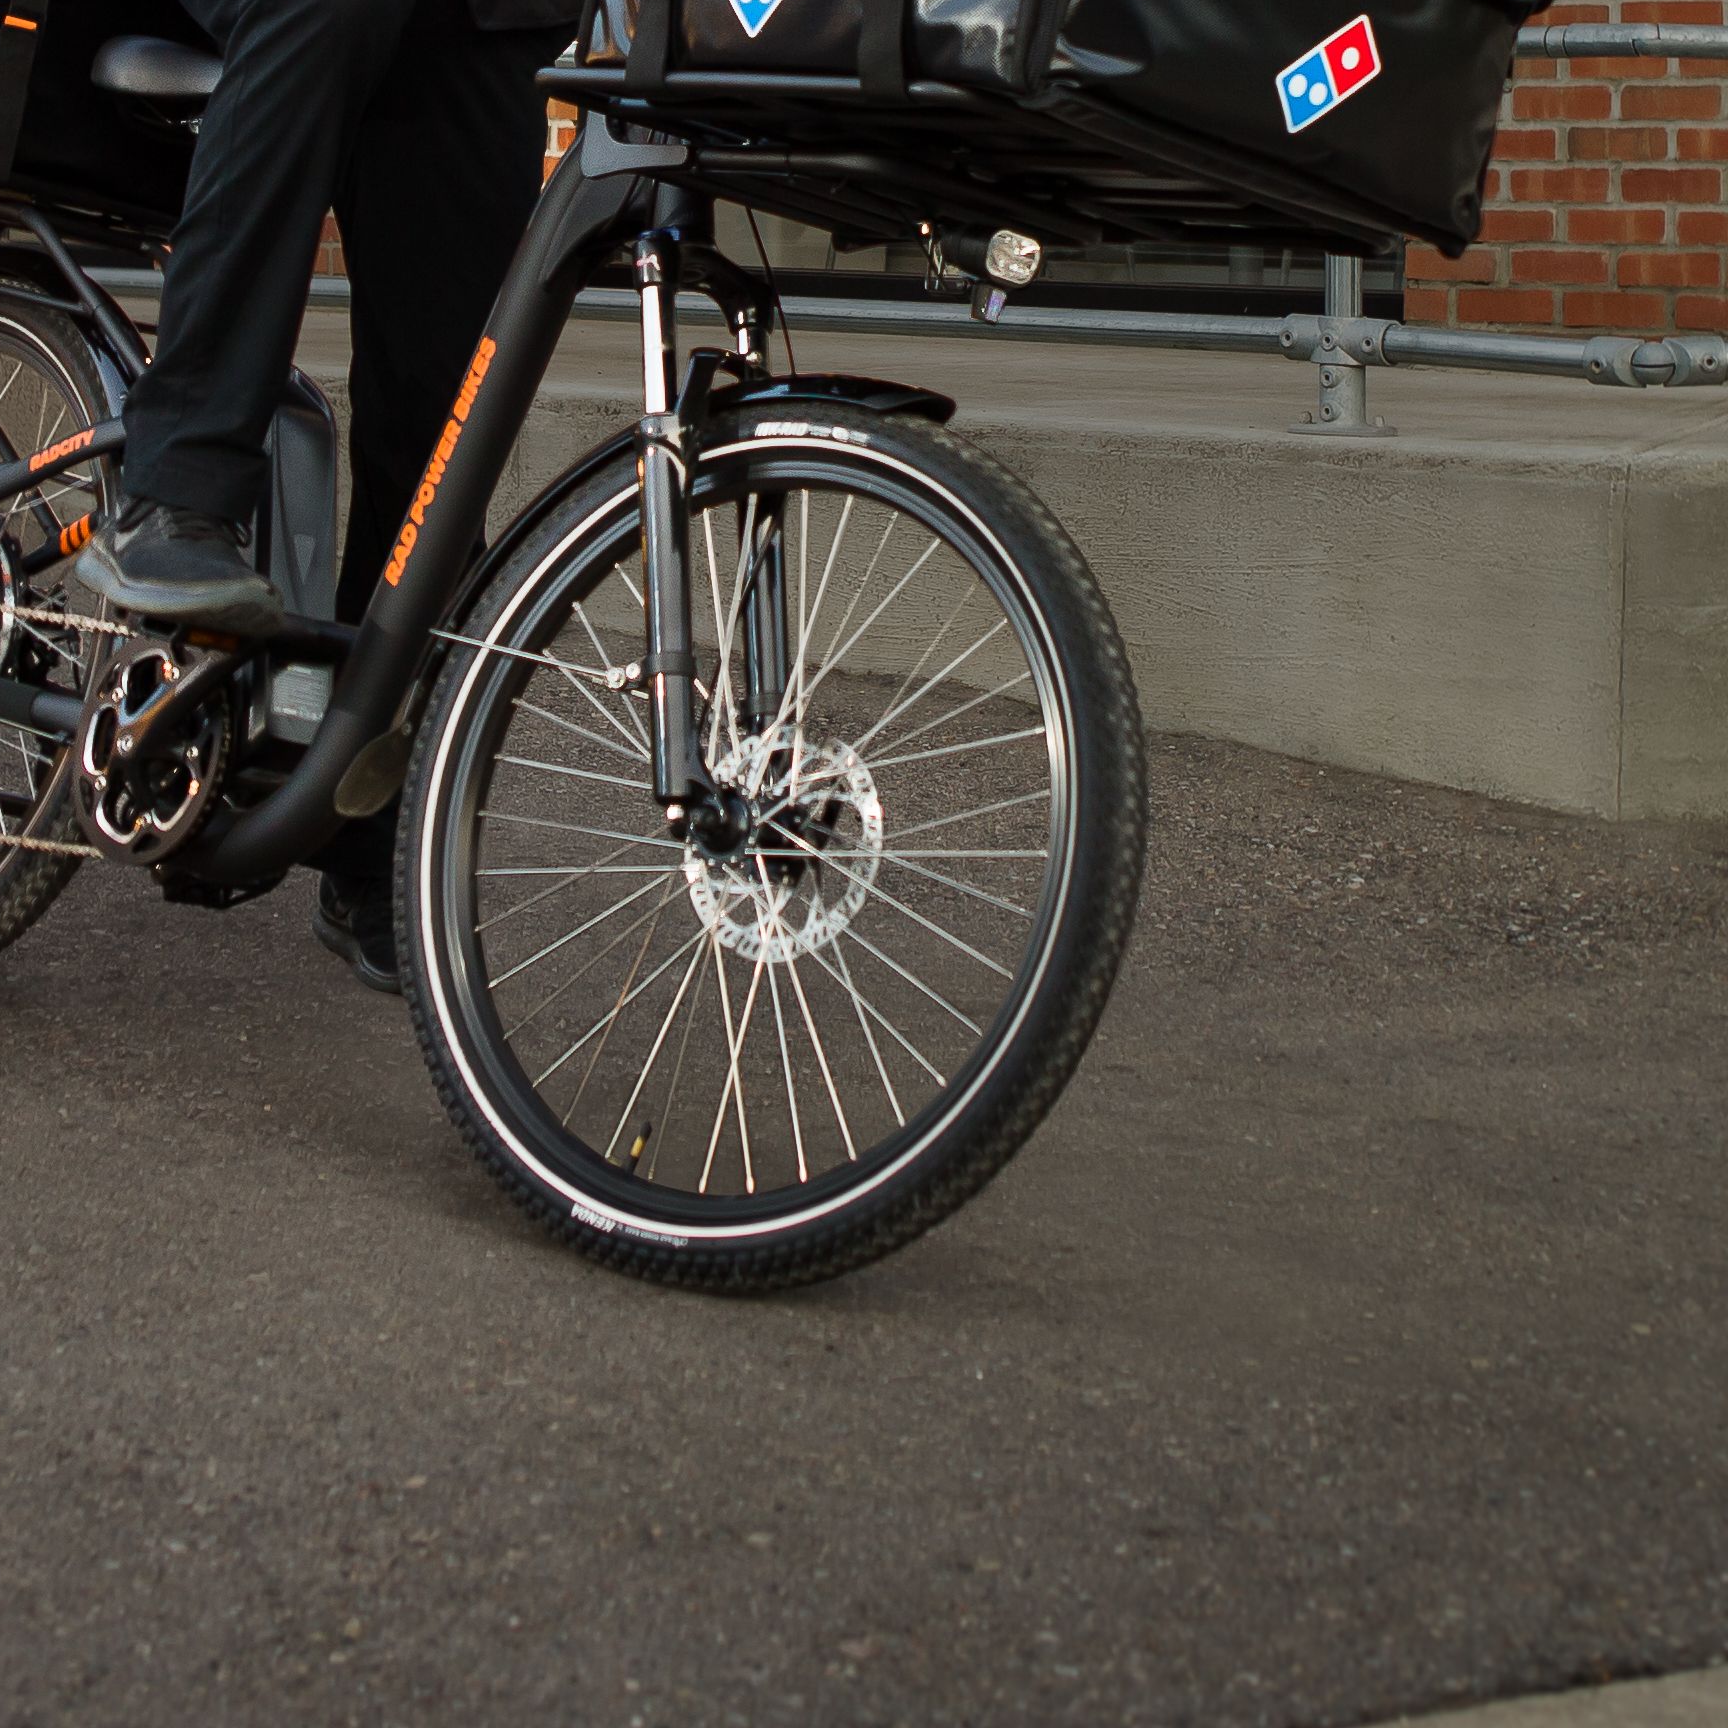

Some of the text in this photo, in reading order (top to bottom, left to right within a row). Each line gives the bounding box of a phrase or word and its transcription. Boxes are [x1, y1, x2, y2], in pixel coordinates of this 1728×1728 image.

[29, 427, 97, 472] RADCITY
[385, 336, 497, 588] RAD POWER BIKES
[570, 1202, 616, 1233] KENDA
